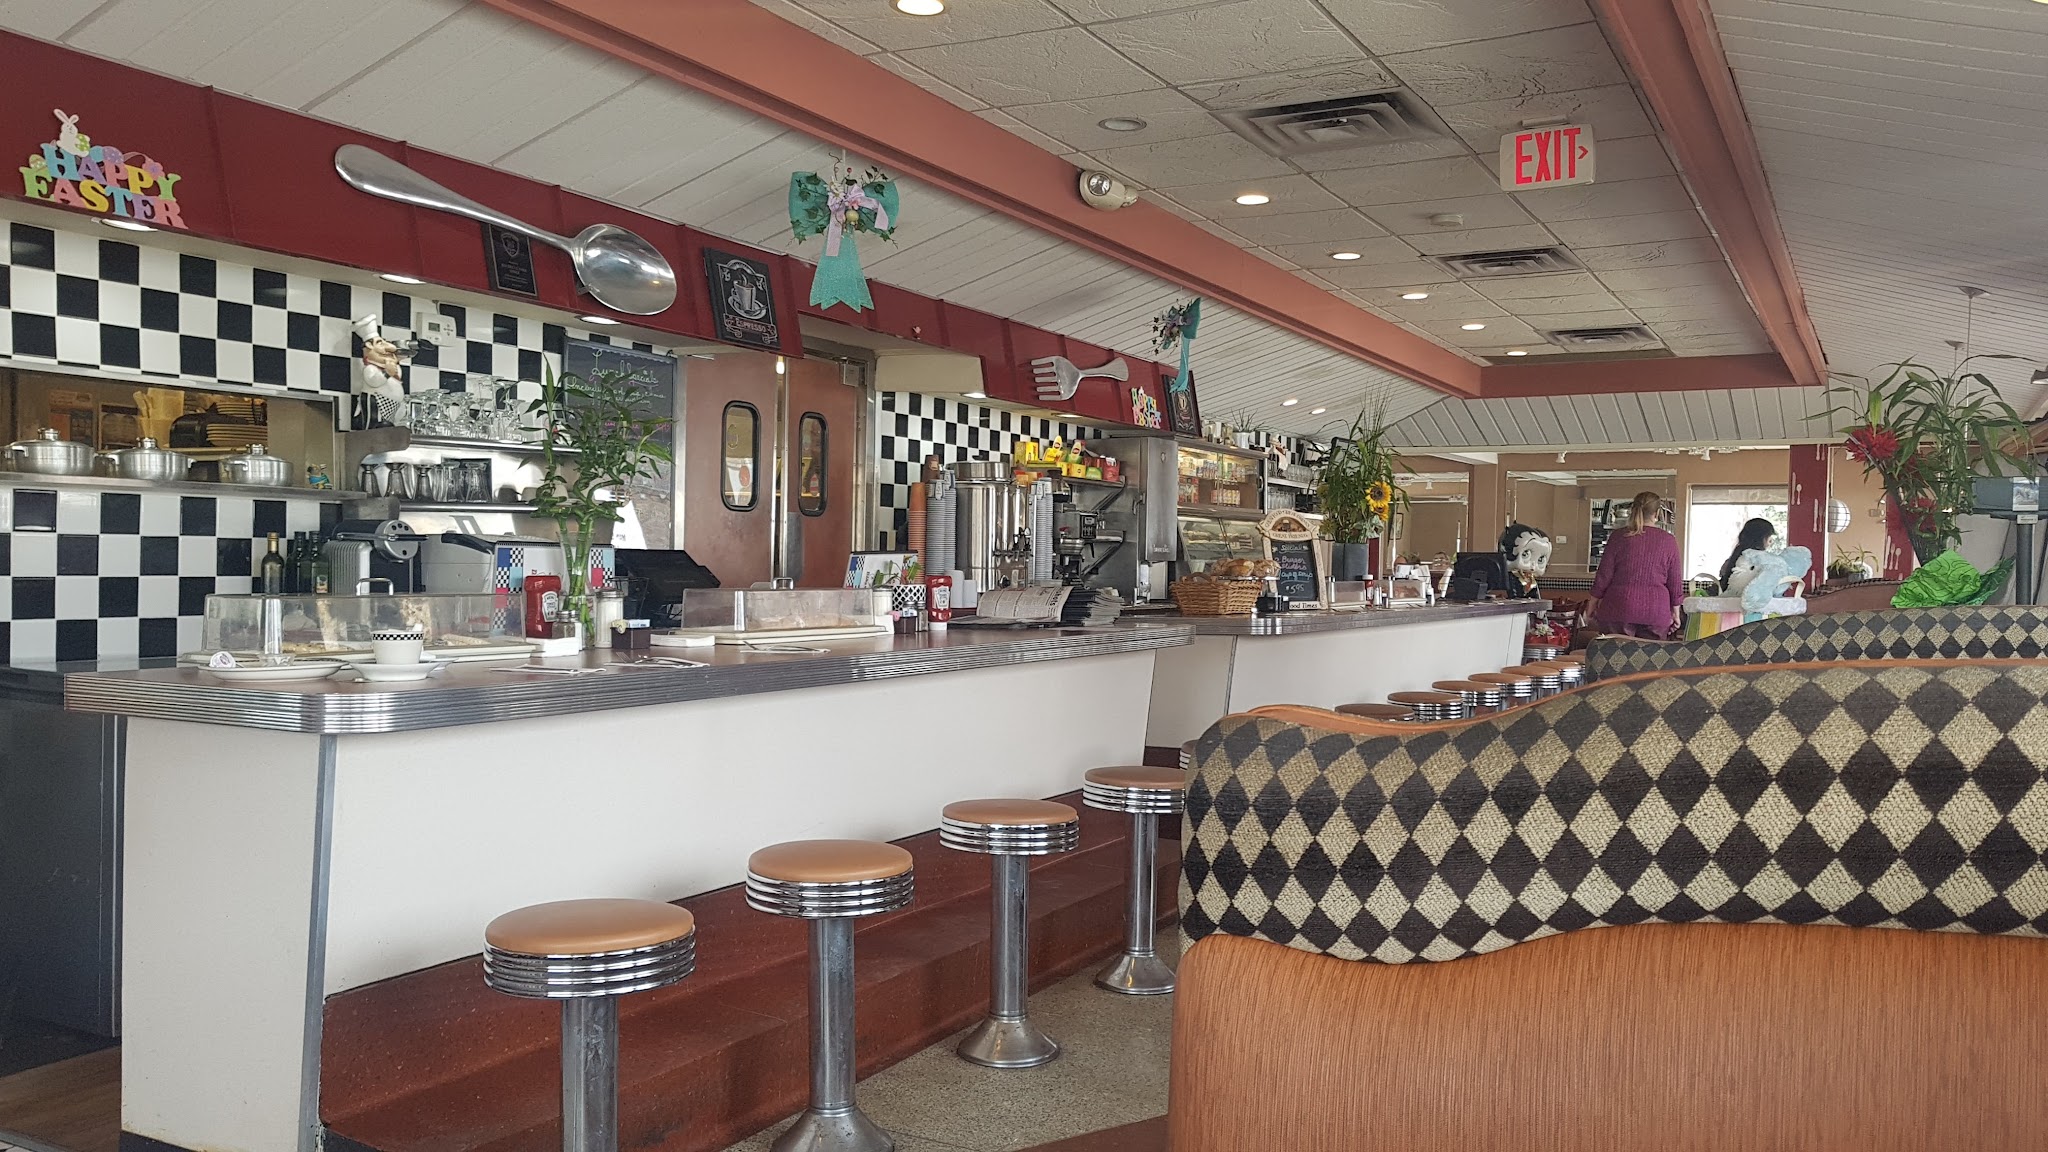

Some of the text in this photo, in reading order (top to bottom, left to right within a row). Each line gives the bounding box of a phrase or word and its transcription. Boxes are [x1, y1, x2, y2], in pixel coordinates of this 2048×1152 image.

[40, 143, 182, 201] HAPPY
[1515, 128, 1581, 185] EXIT
[19, 166, 189, 230] EASTER
